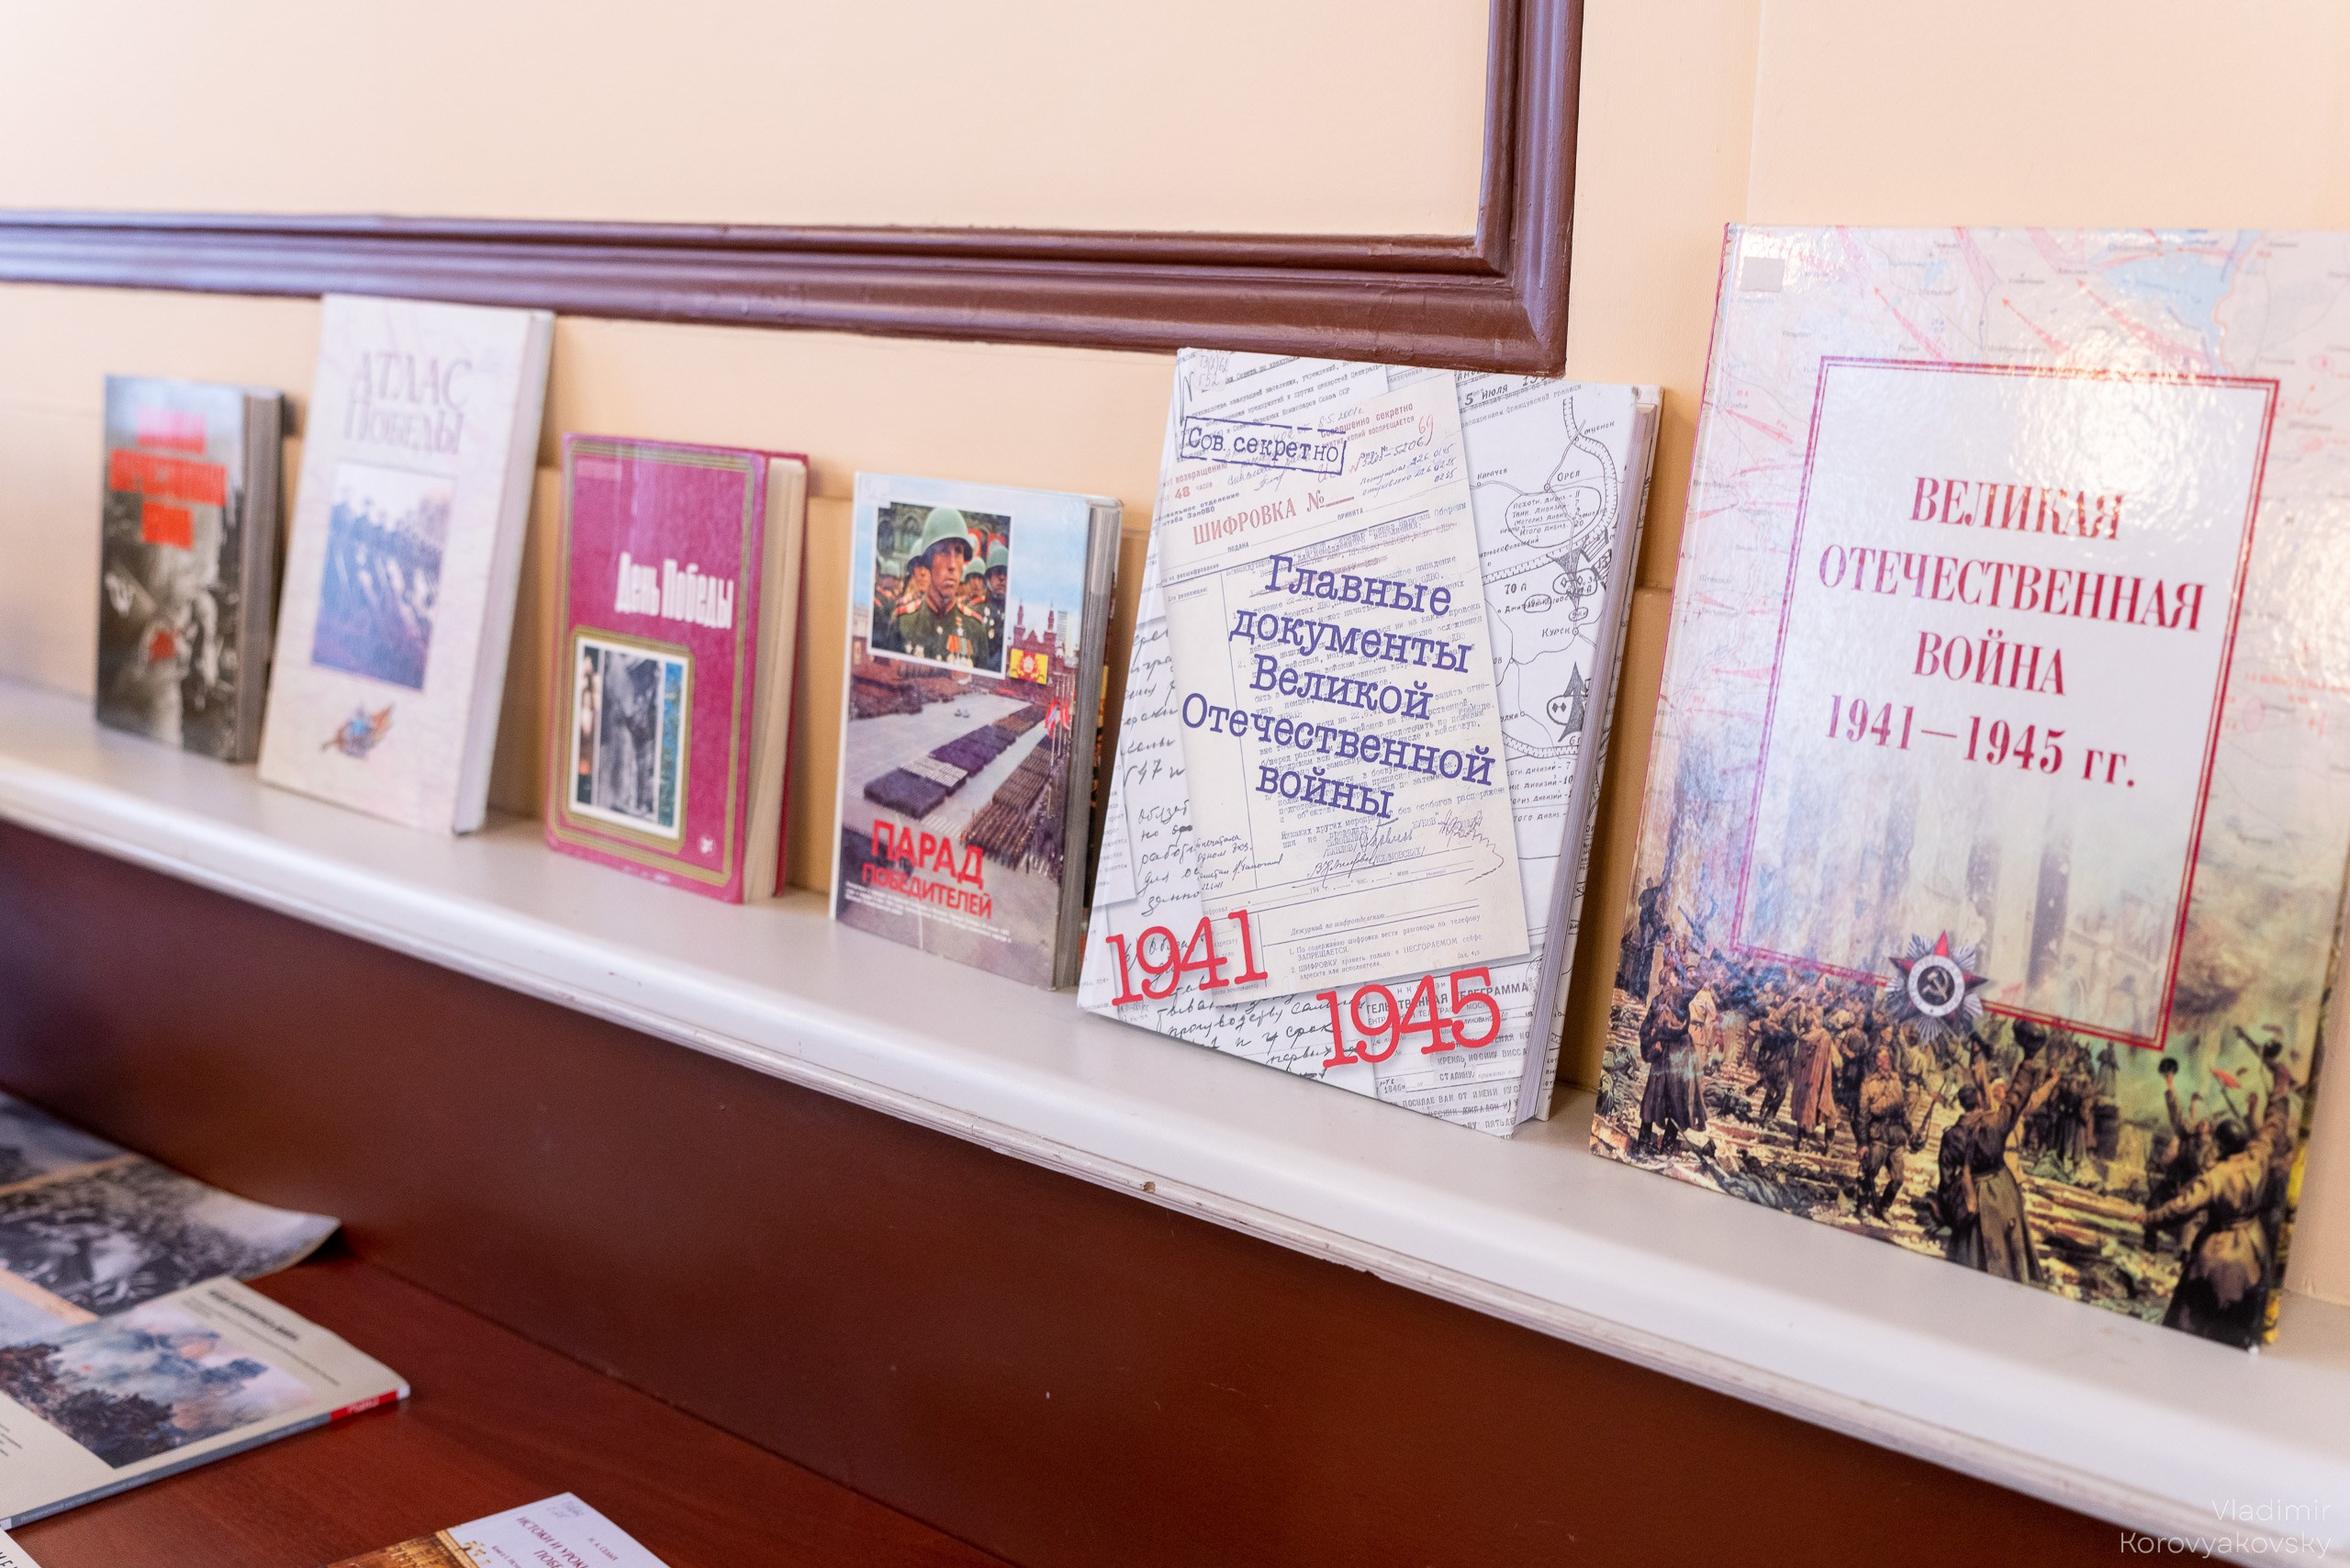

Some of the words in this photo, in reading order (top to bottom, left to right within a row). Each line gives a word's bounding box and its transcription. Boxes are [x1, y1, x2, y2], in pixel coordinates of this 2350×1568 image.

[350, 352, 473, 409] АТЛАС
[1375, 401, 1413, 422] секретно
[1189, 427, 1225, 452] Сов.
[1234, 436, 1338, 464] секретно
[1174, 485, 1191, 500] 48
[1192, 496, 1296, 546] ШИФРОВКА
[1909, 476, 2125, 541] ВЕЛИКАЯ
[615, 553, 660, 616] День
[663, 558, 733, 629] Победы
[1264, 554, 1451, 616] Главные
[1818, 544, 2209, 632] ОТЕЧЕСТВЕННАЯ
[1227, 610, 1473, 674] документы
[1912, 628, 2066, 696] ВОЙНА
[1249, 653, 1434, 720] Великой
[1181, 693, 1495, 786] Отечественной
[2081, 747, 2136, 788] гг.
[1256, 765, 1393, 819] войны
[872, 820, 984, 890] ПАРАД
[862, 863, 992, 919] ПОБЕДИТЕЛЕЙ
[1105, 909, 1268, 1006] 1941
[1316, 966, 1503, 1070] 1945
